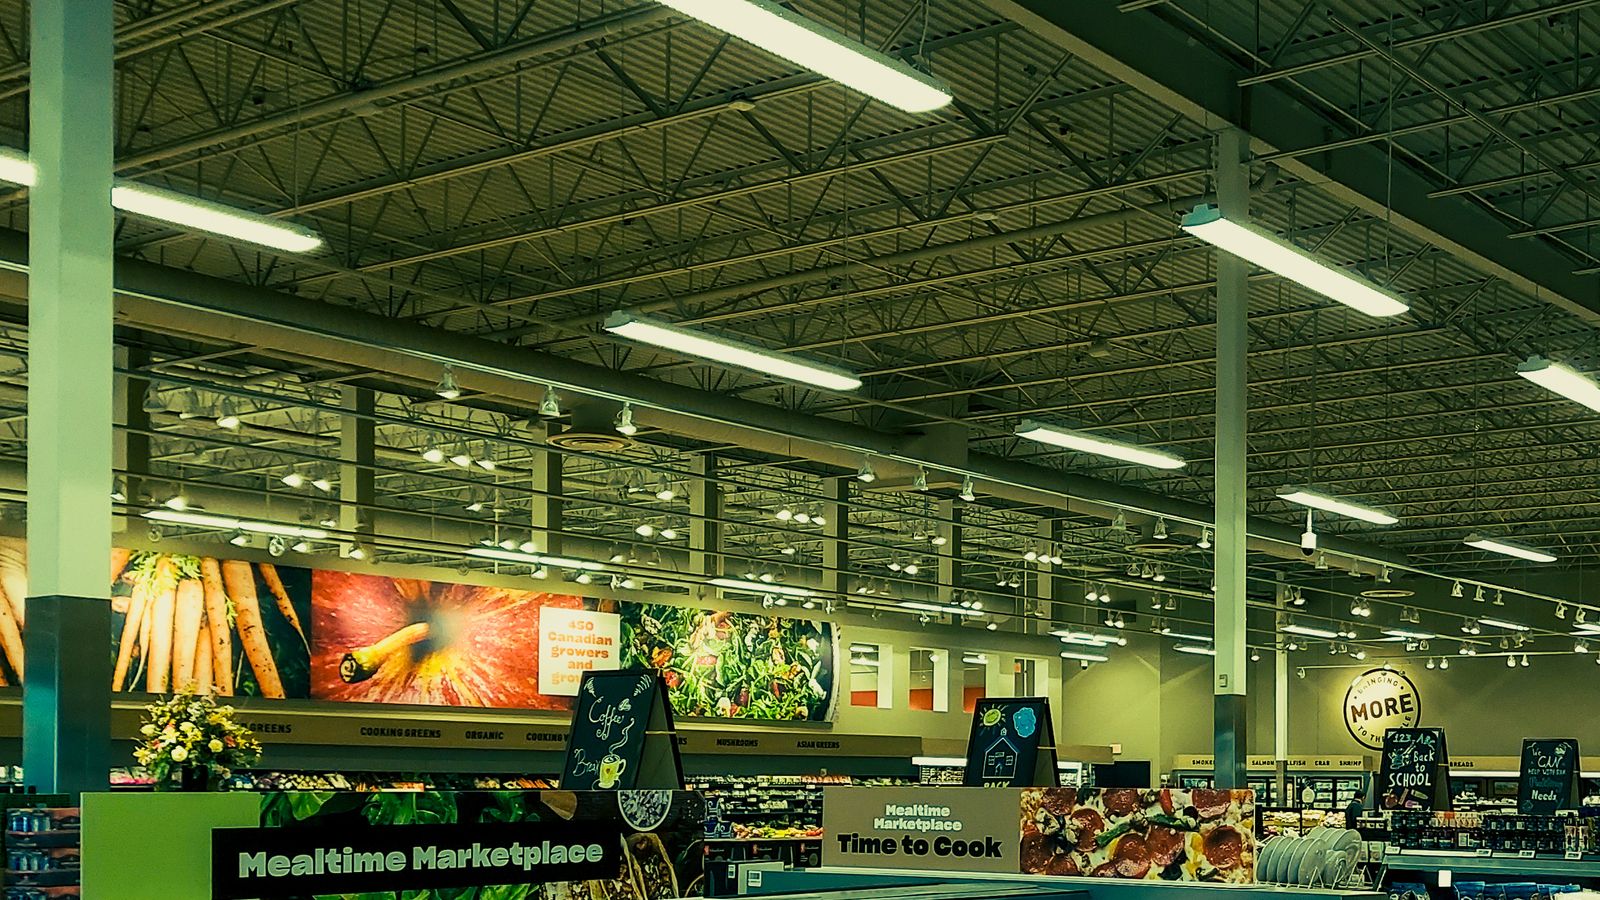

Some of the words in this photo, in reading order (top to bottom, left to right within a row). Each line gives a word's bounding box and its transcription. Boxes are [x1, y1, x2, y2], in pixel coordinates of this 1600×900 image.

[568, 620, 594, 631] 450
[547, 631, 613, 646] Canadian
[551, 645, 609, 659] growers
[567, 660, 593, 670] and
[1350, 692, 1414, 724] MORE
[588, 696, 625, 741] Coffee
[360, 726, 403, 737] COOKING
[404, 728, 441, 739] GREENS
[465, 731, 504, 740] ORGANIC
[1357, 725, 1368, 737] TO
[716, 738, 759, 747] MUSHROOMS
[1413, 749, 1435, 763] Back
[1415, 763, 1426, 773] to
[1388, 772, 1432, 788] SCHOOL
[1531, 789, 1557, 801] Needs
[885, 804, 951, 817] Mealtime
[873, 817, 963, 833] Marketplace
[837, 833, 898, 855] Time
[901, 834, 929, 856] to
[933, 835, 1003, 858] Cook
[238, 846, 407, 879] Mealtime
[412, 840, 604, 871] Marketplace
